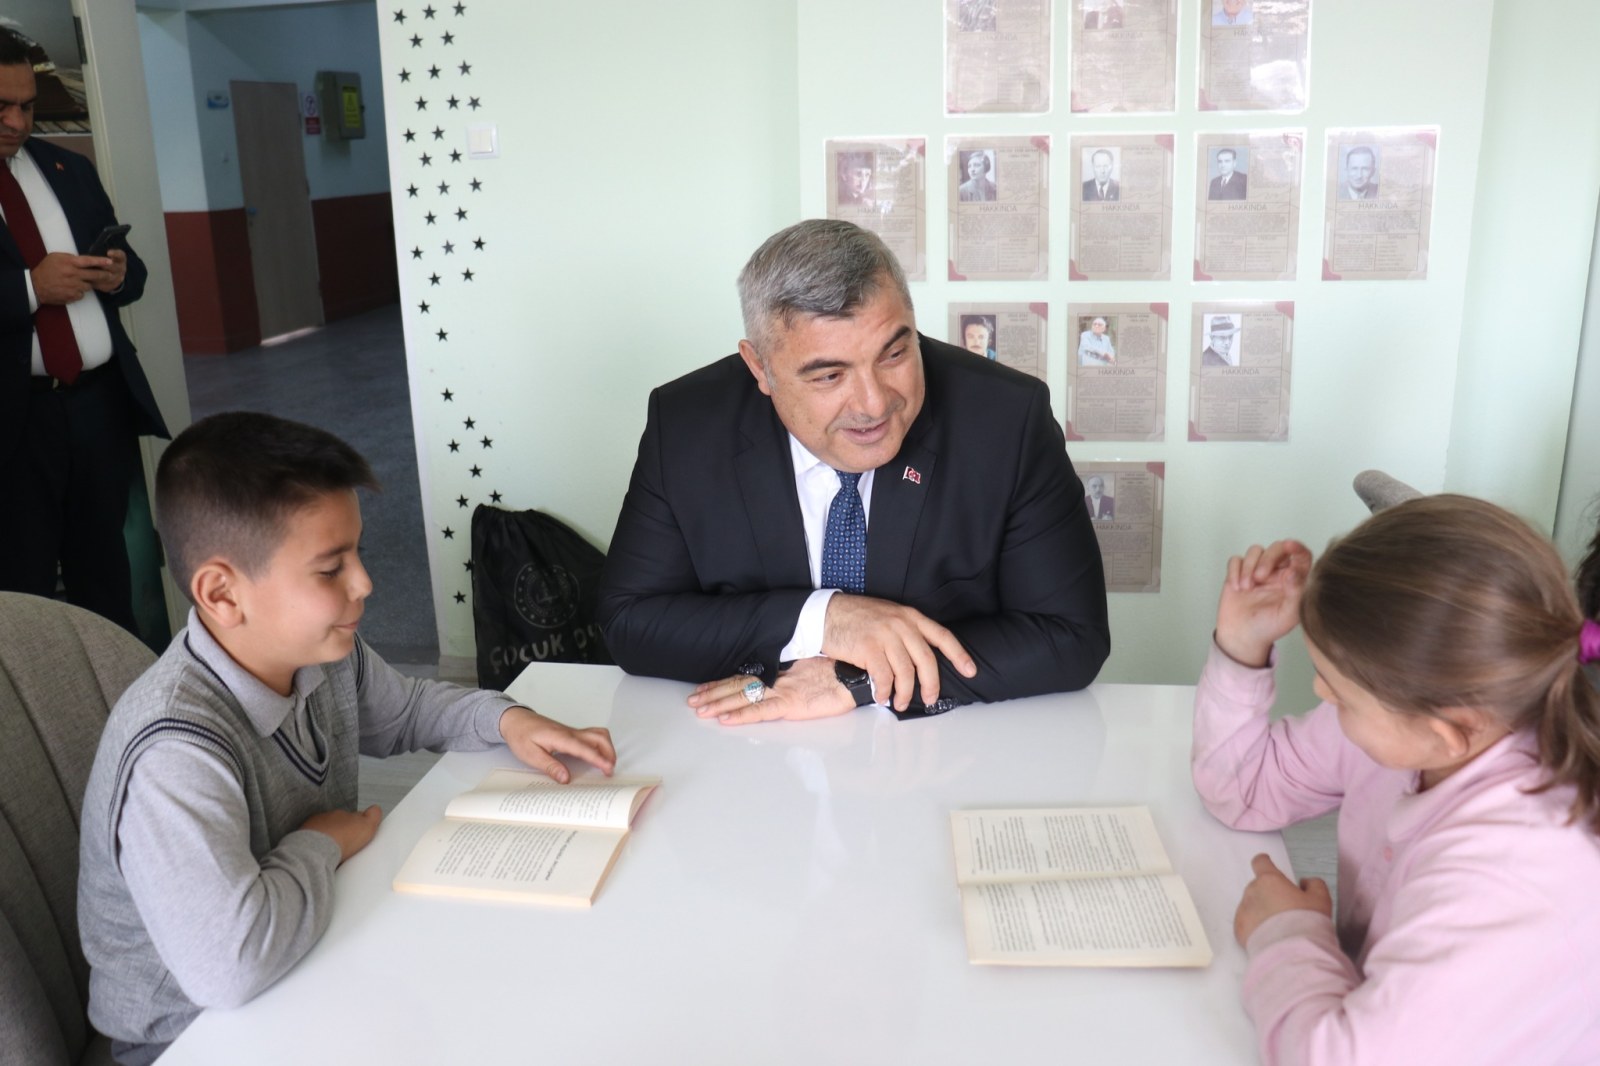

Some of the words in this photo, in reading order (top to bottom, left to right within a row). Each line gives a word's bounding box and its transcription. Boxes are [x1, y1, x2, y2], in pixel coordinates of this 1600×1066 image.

[979, 204, 1018, 213] HAKKINDA
[1102, 204, 1140, 212] HAKKINDA
[1228, 203, 1267, 211] HAKKINDA
[1358, 202, 1398, 210] HAKKINDA
[1098, 368, 1136, 376] HAKKINDA
[1221, 368, 1260, 376] HAKKINDA
